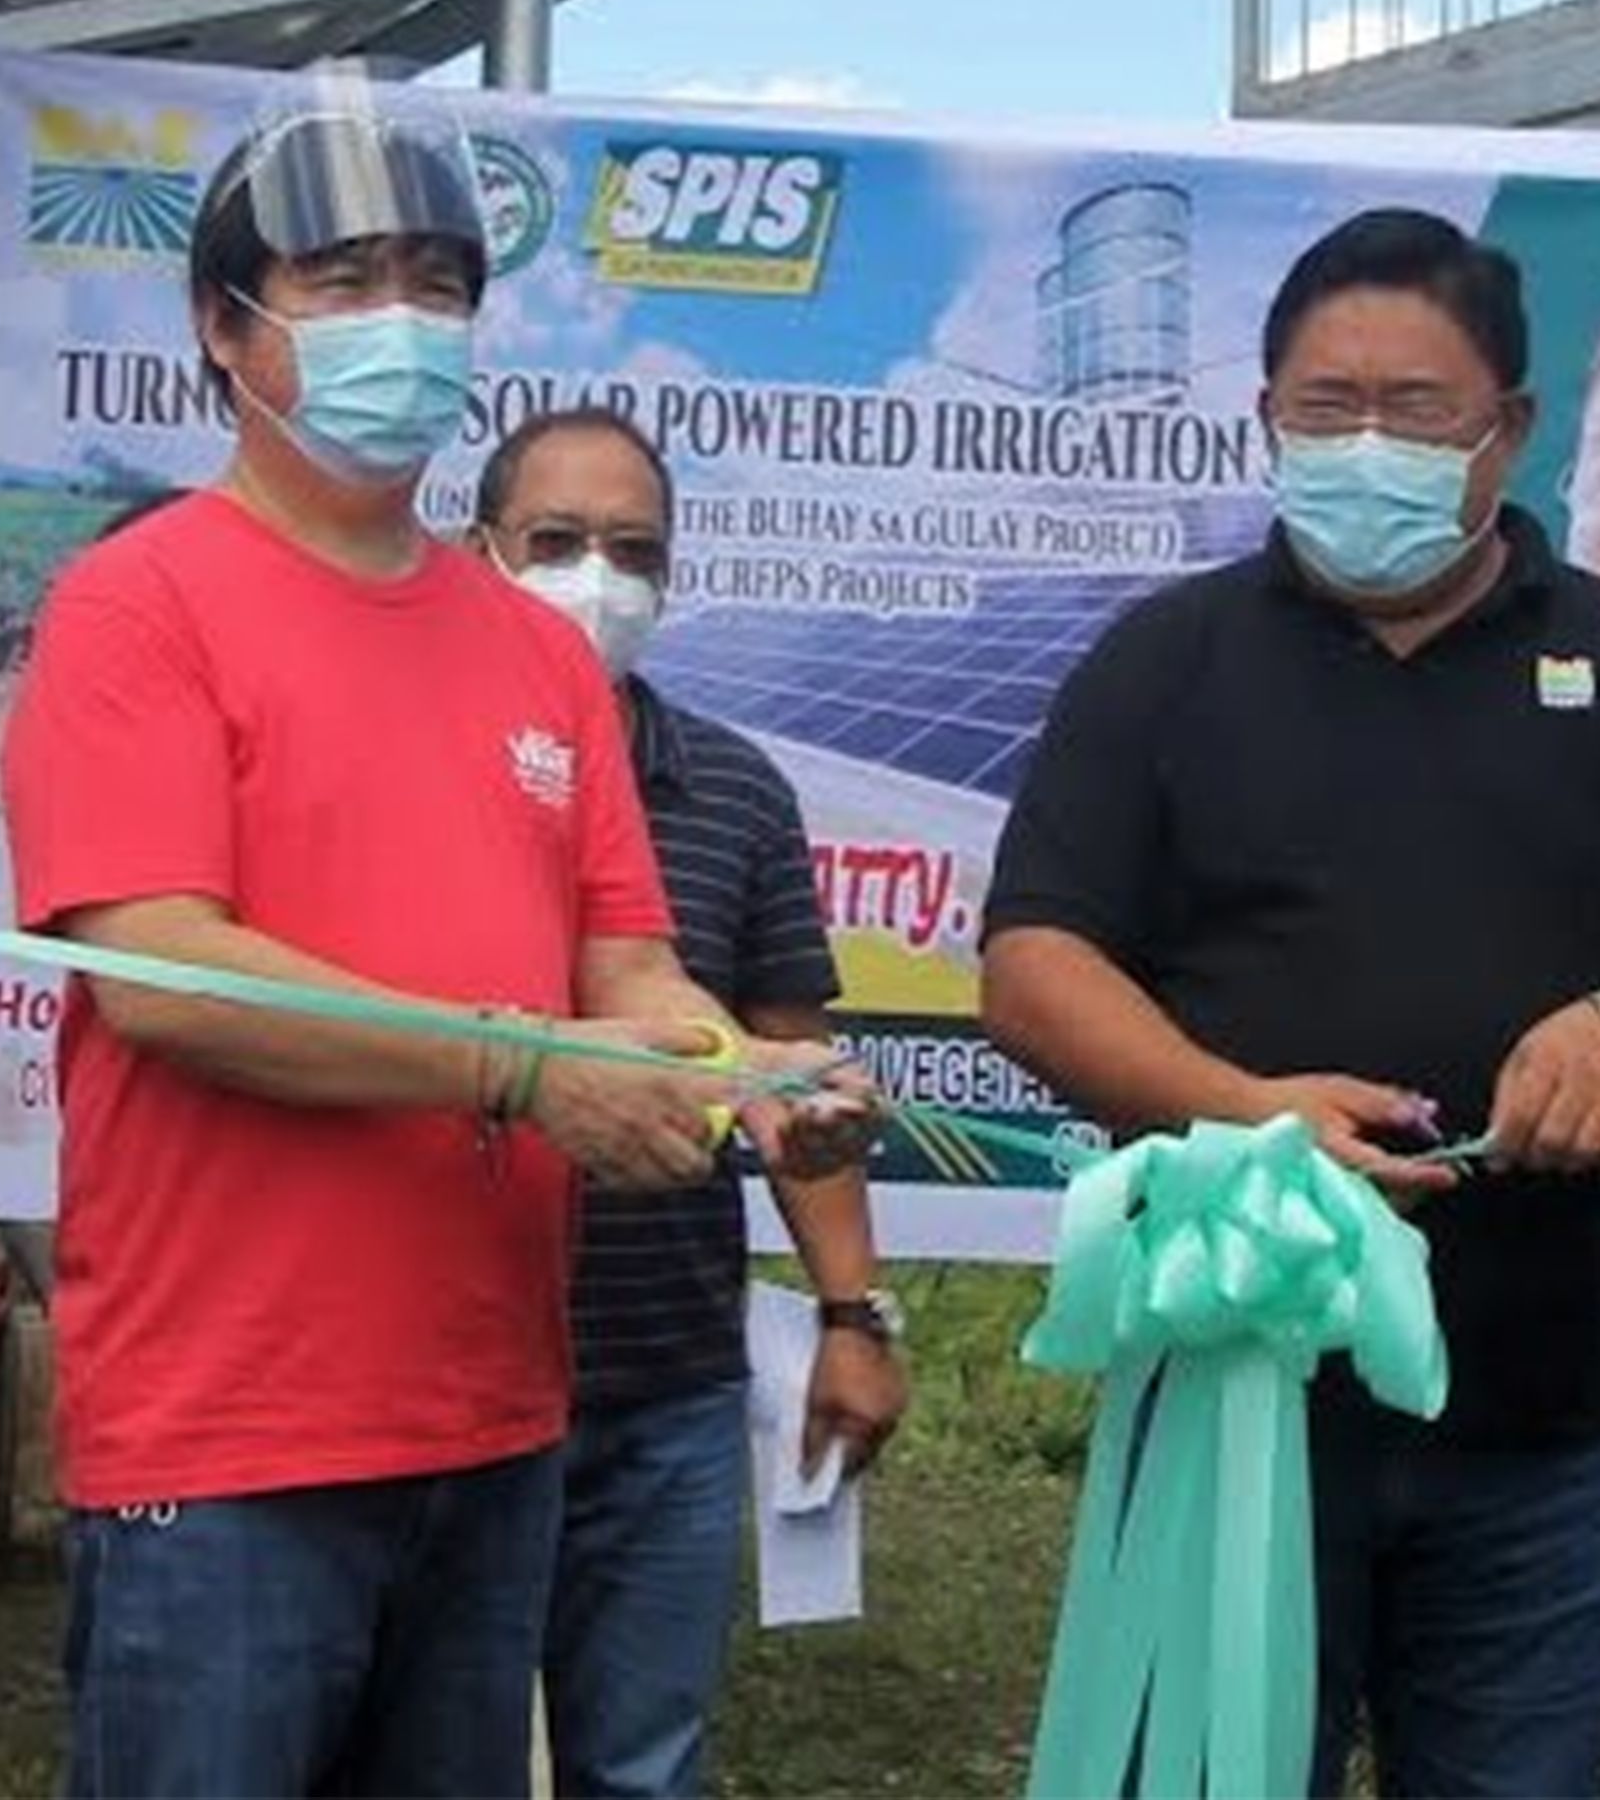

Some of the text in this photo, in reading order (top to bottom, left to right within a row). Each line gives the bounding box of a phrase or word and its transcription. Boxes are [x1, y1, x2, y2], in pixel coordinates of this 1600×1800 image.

[608, 145, 823, 252] SPIS
[654, 382, 918, 470] POWERED
[931, 399, 1252, 486] IRRIGATION
[682, 497, 739, 535] THE
[748, 498, 863, 543] BUHAY
[911, 505, 1019, 550] GULAY
